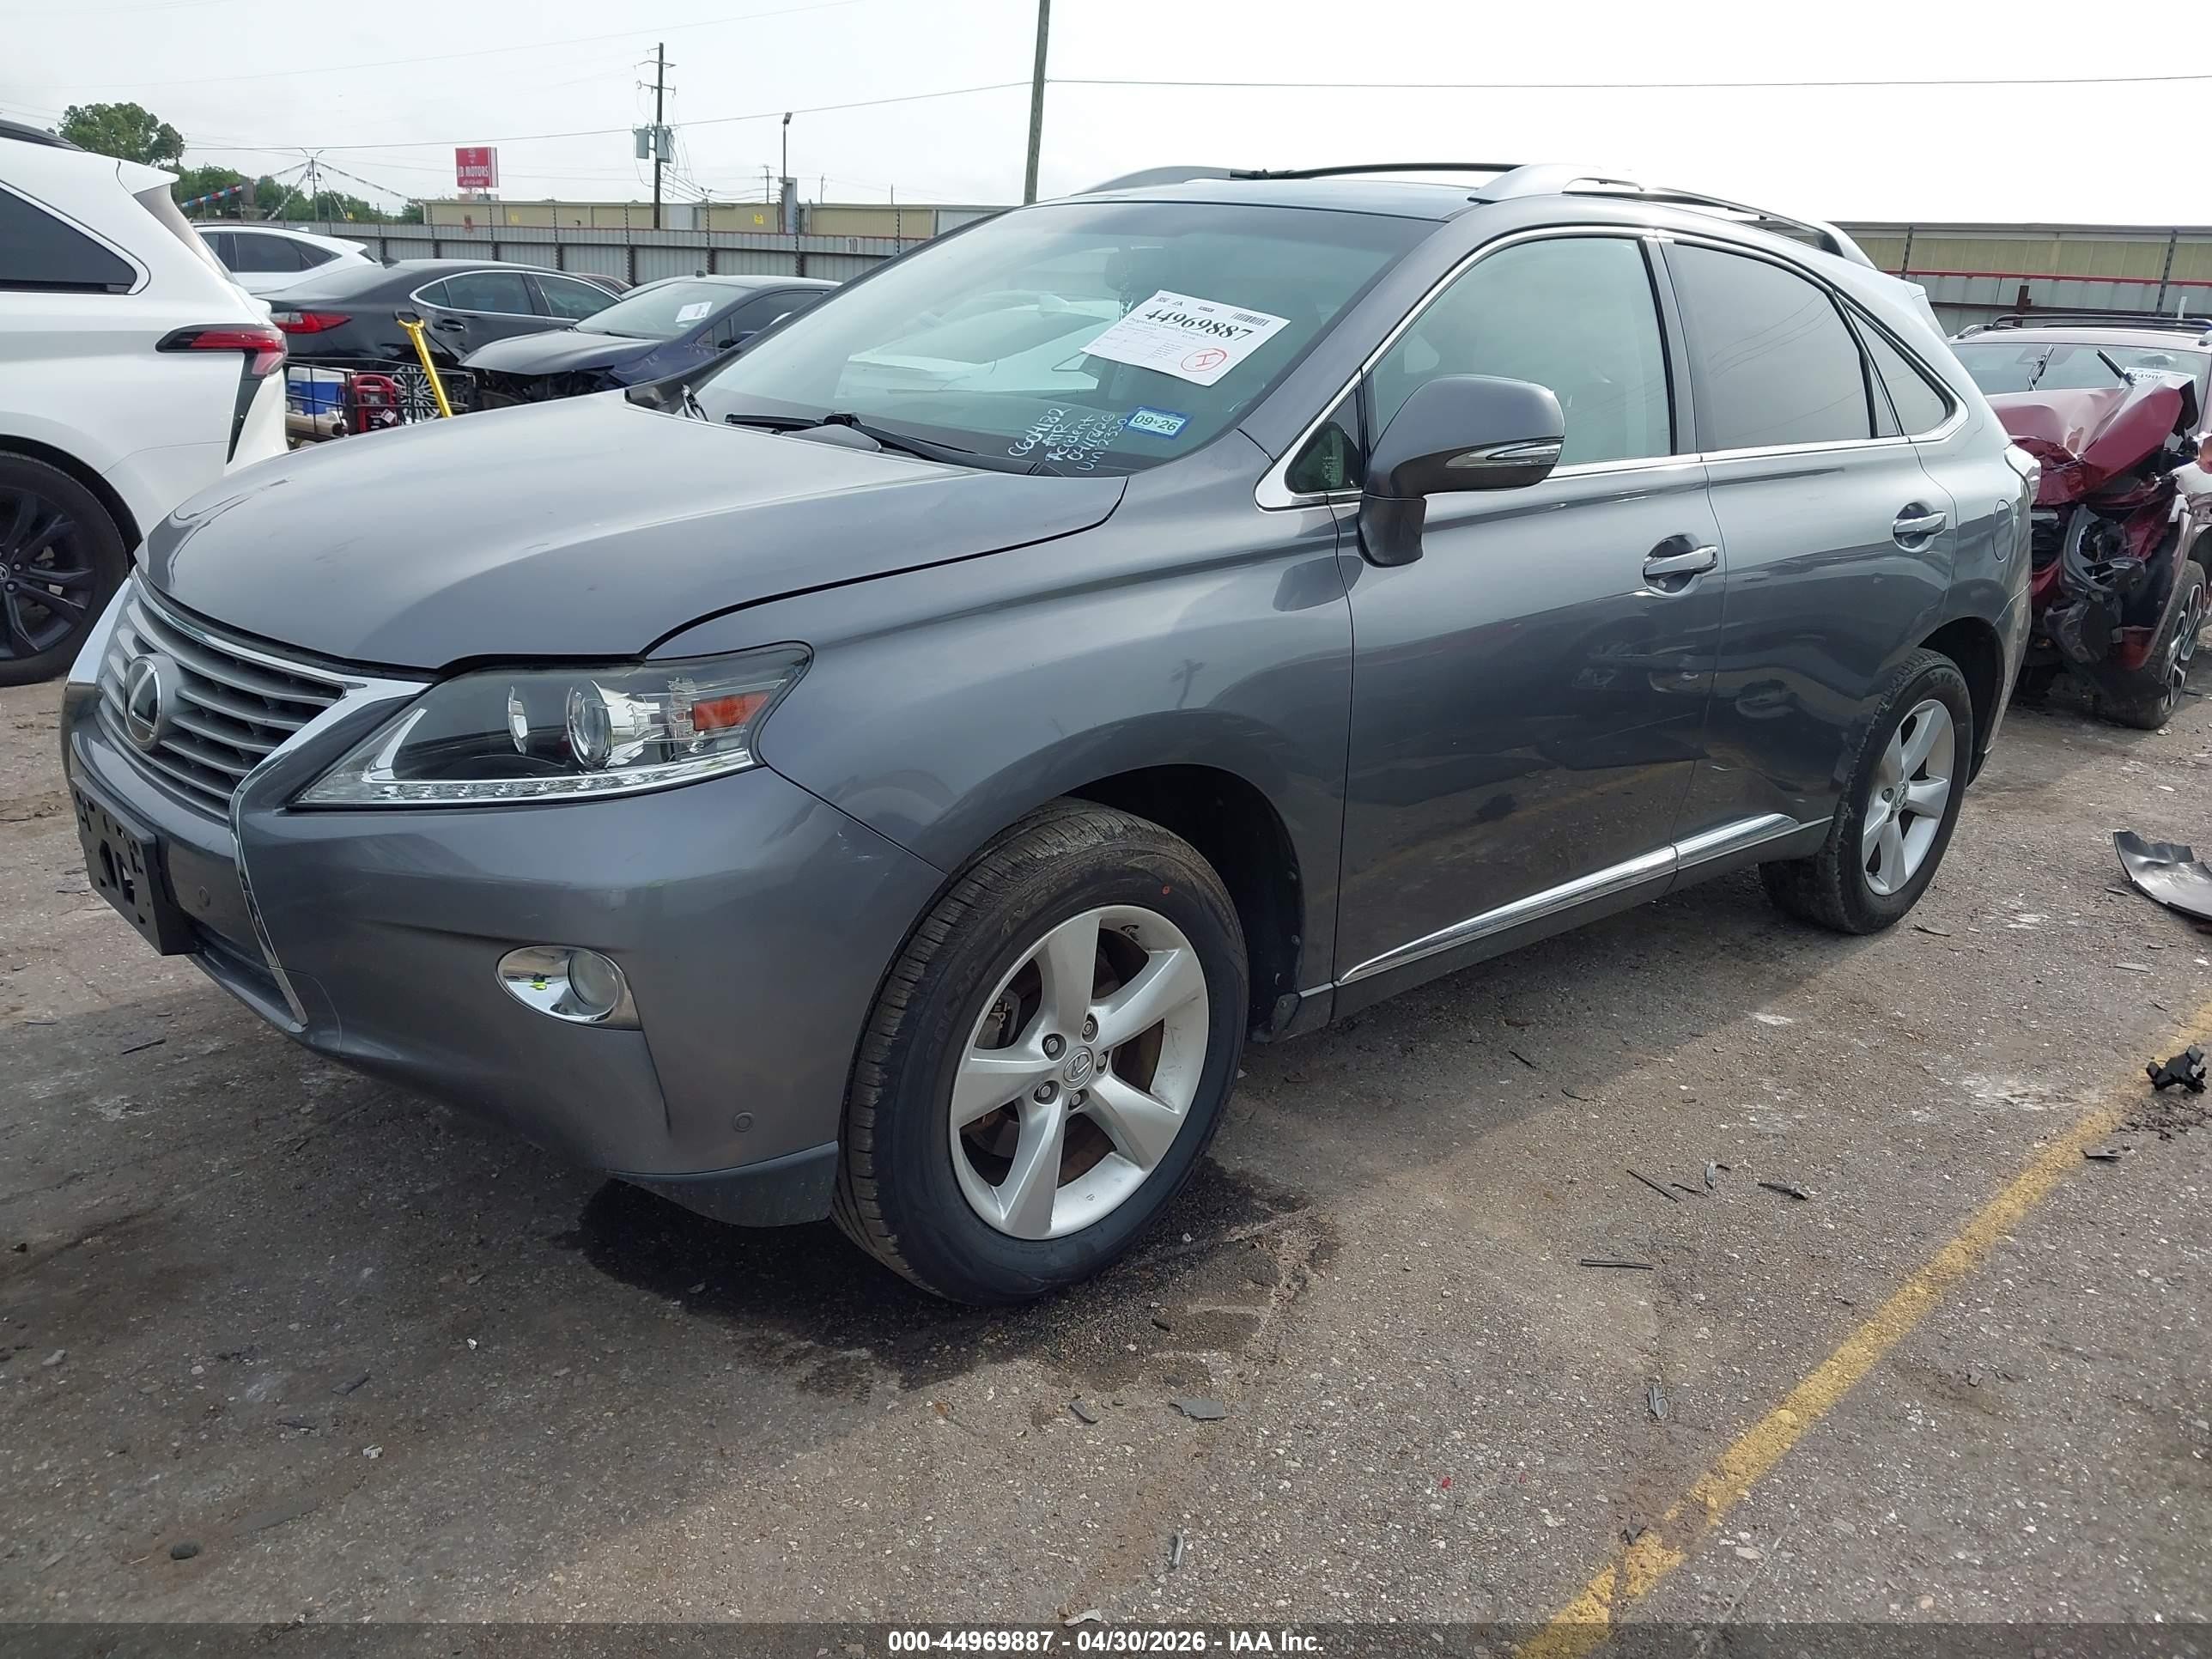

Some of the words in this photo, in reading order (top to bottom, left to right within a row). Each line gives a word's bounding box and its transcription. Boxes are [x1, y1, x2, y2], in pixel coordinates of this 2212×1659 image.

[465, 165, 489, 177] MOTORS
[848, 238, 858, 252] 10
[1145, 308, 1255, 342] 44969887
